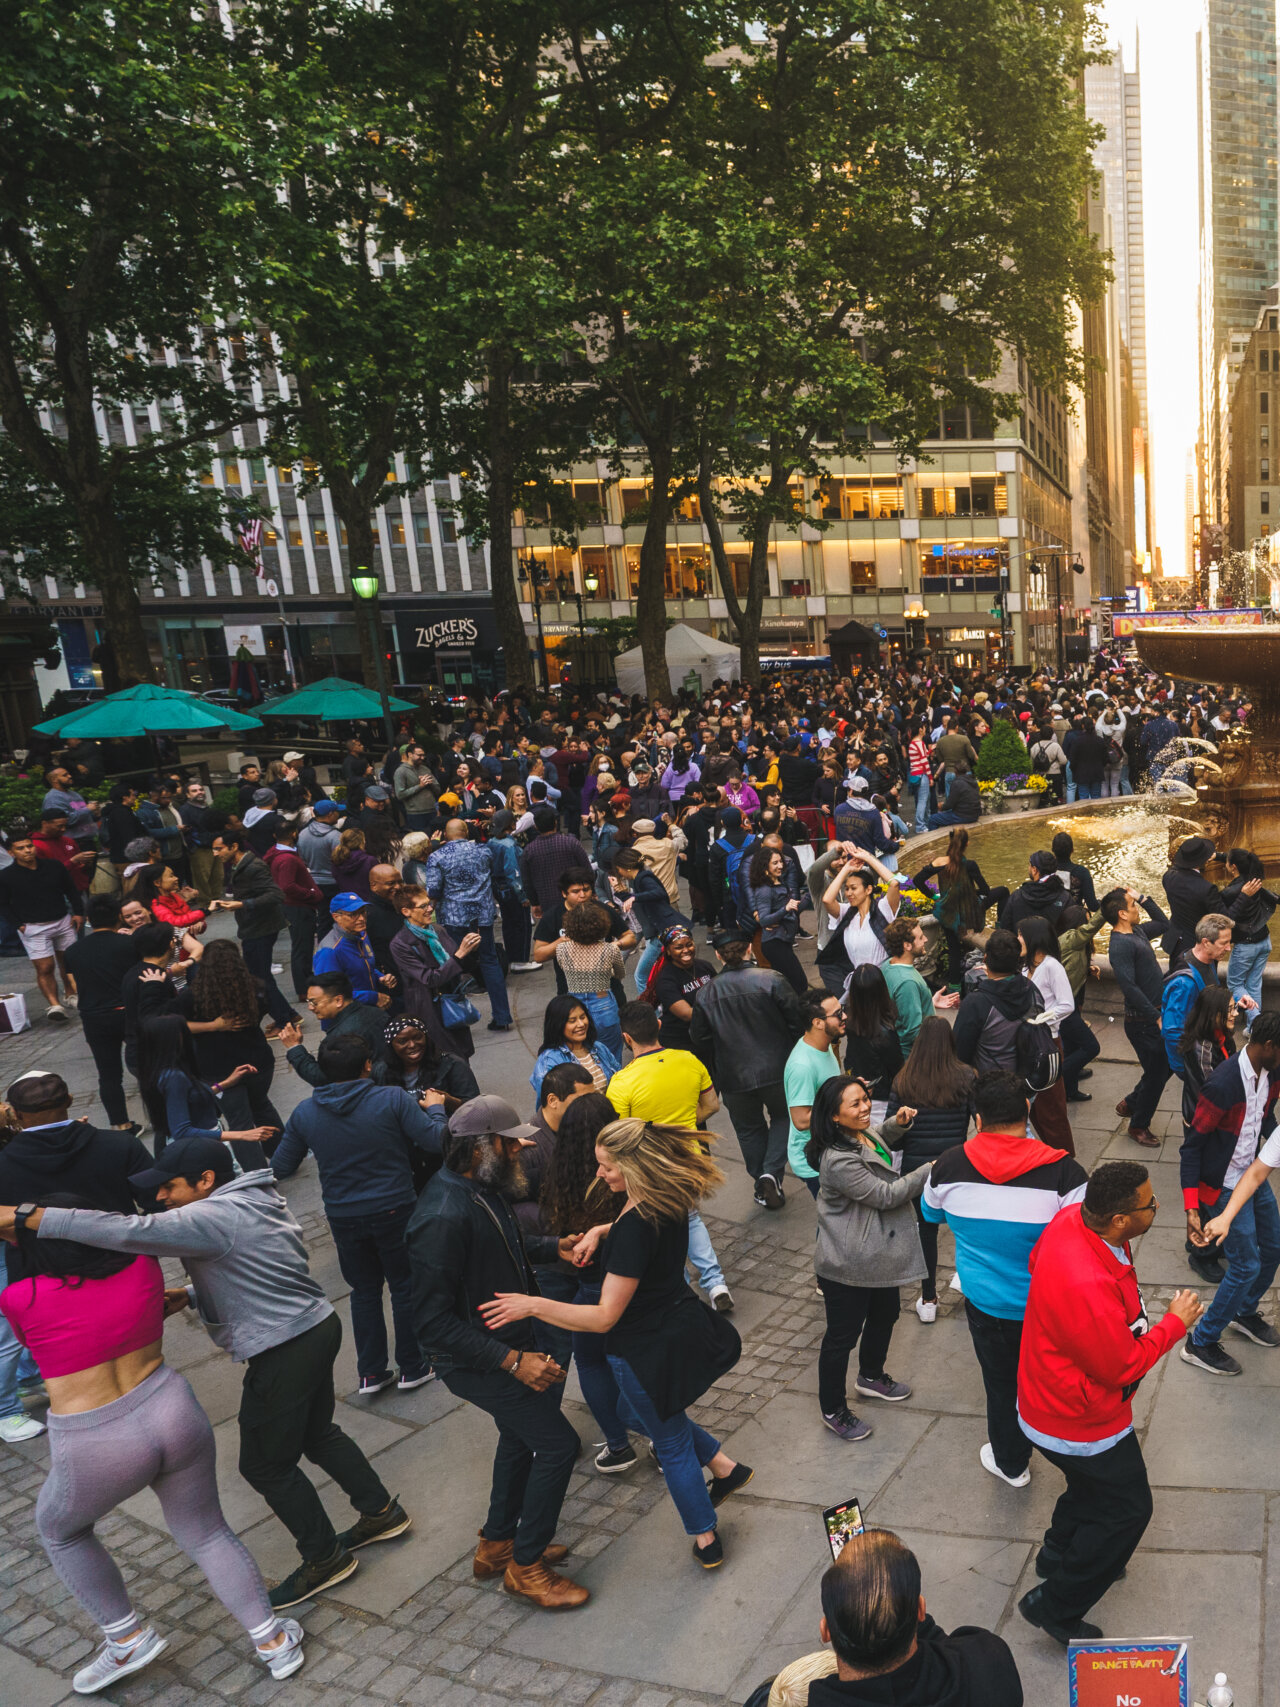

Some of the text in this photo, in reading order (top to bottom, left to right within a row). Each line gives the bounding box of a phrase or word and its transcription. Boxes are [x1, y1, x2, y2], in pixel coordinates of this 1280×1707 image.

[415, 618, 478, 648] ZUCKER'S
[774, 660, 791, 669] bus
[1092, 1659, 1164, 1670] DANCE PARTY
[1116, 1695, 1142, 1707] No
